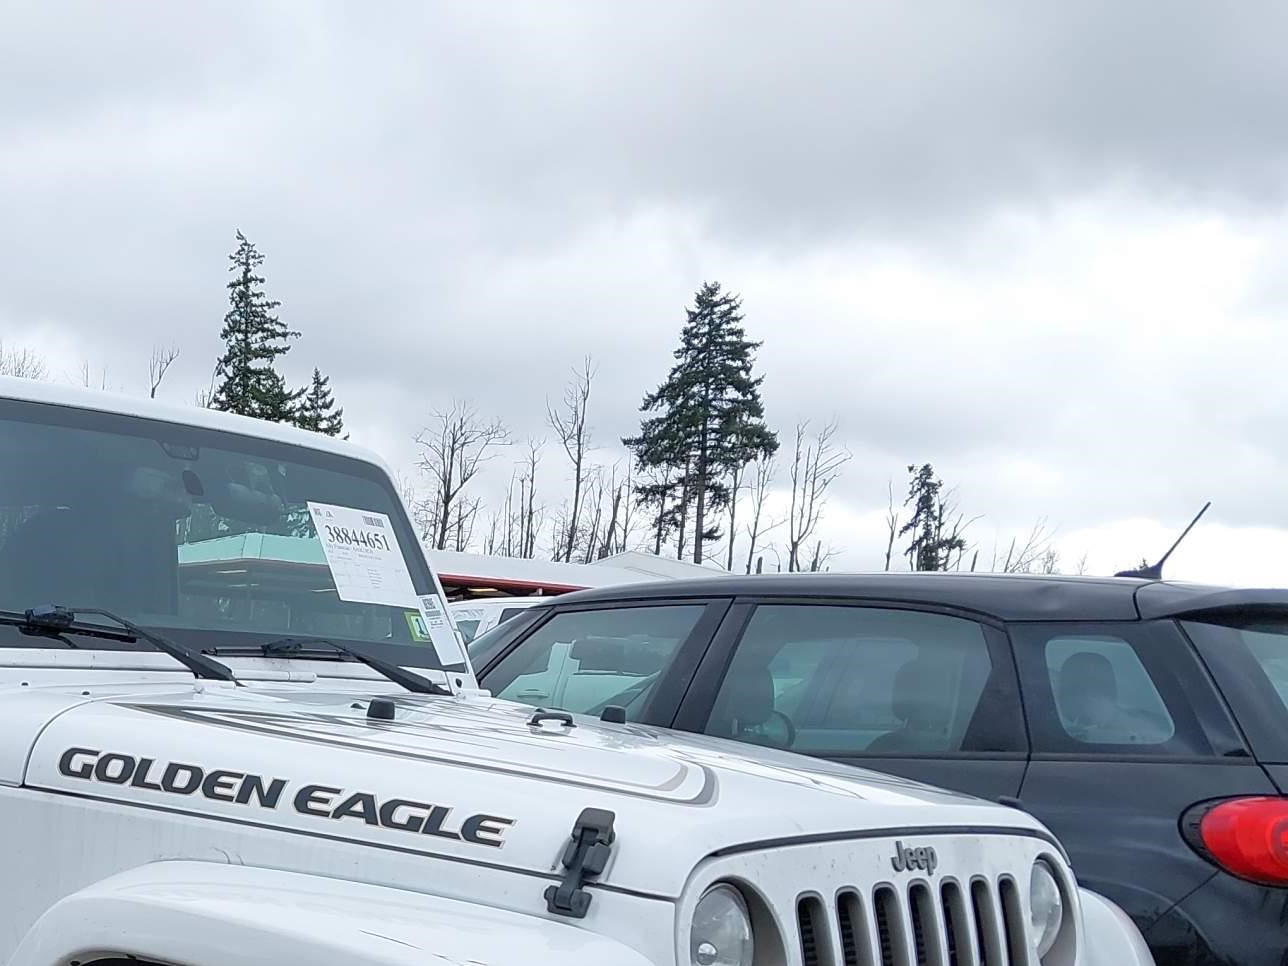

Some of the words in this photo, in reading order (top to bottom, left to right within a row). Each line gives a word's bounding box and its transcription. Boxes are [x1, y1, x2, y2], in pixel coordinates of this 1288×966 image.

[324, 524, 391, 551] 38844651
[58, 746, 288, 809] GOLDEN
[293, 784, 515, 848] EAGLE
[891, 840, 938, 876] Jeep
